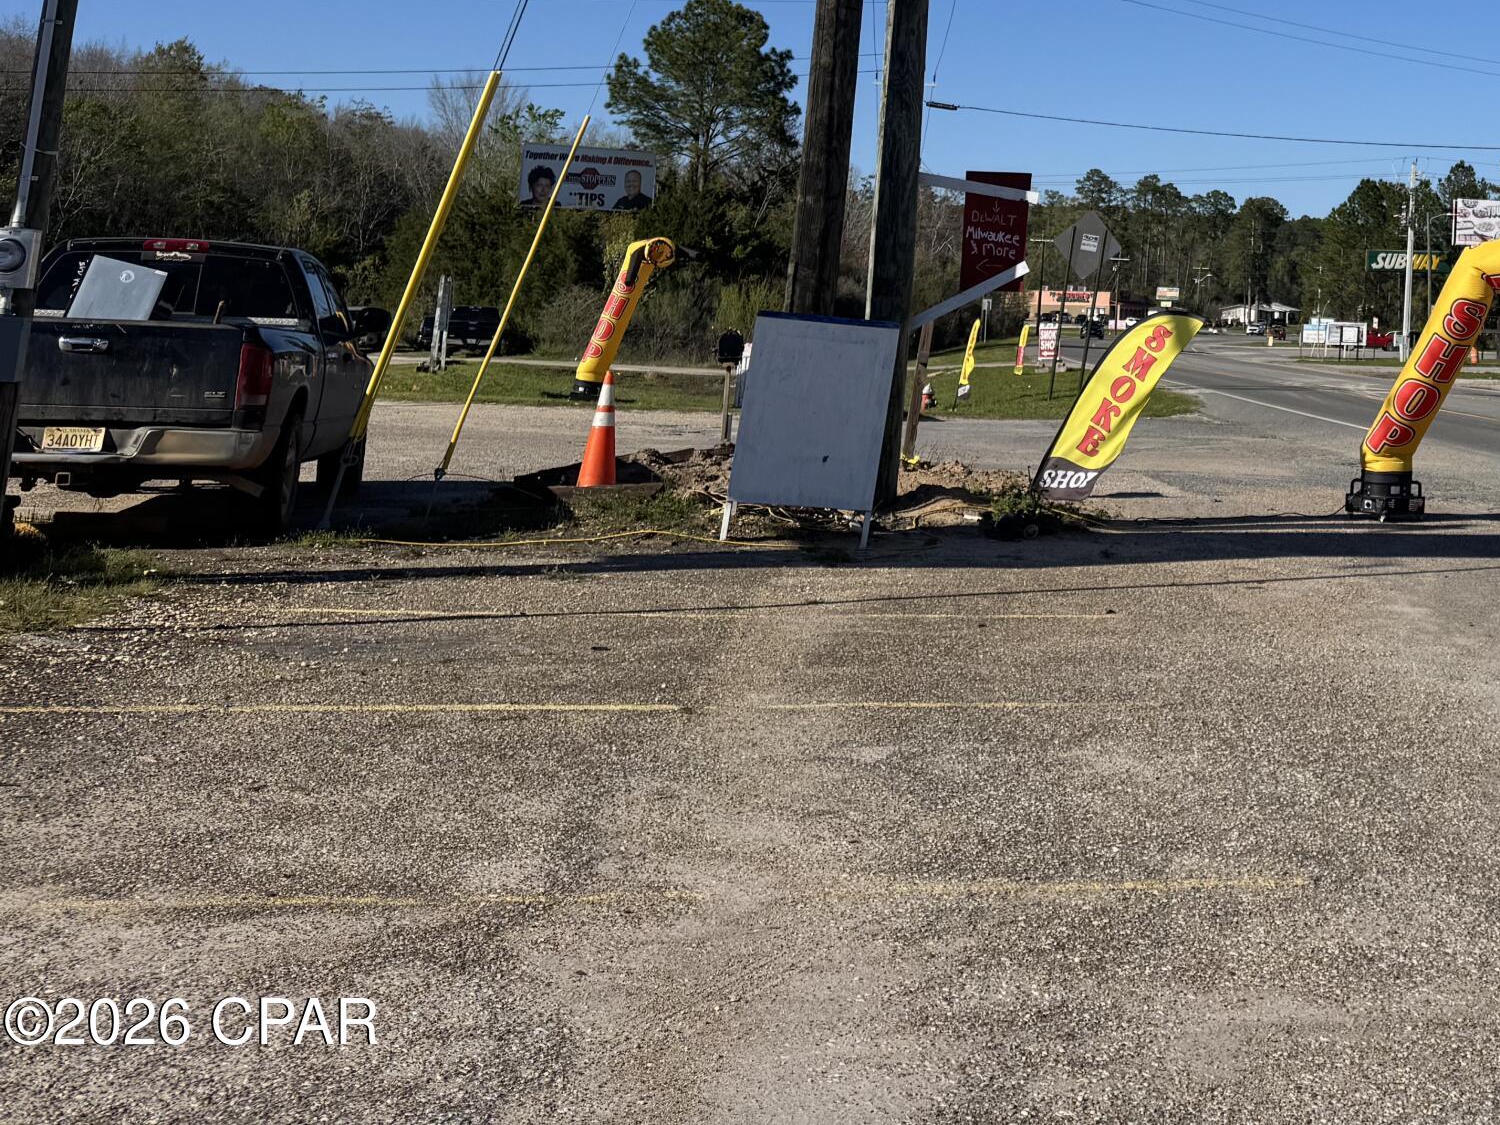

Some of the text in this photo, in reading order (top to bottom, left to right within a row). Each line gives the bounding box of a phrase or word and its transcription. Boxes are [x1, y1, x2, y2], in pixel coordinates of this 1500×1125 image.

[966, 225, 1020, 246] Milwaukee
[1040, 330, 1057, 340] SMOK
[1040, 340, 1056, 351] SHO
[1365, 297, 1488, 455] SHOP
[1075, 324, 1174, 458] SMOKE
